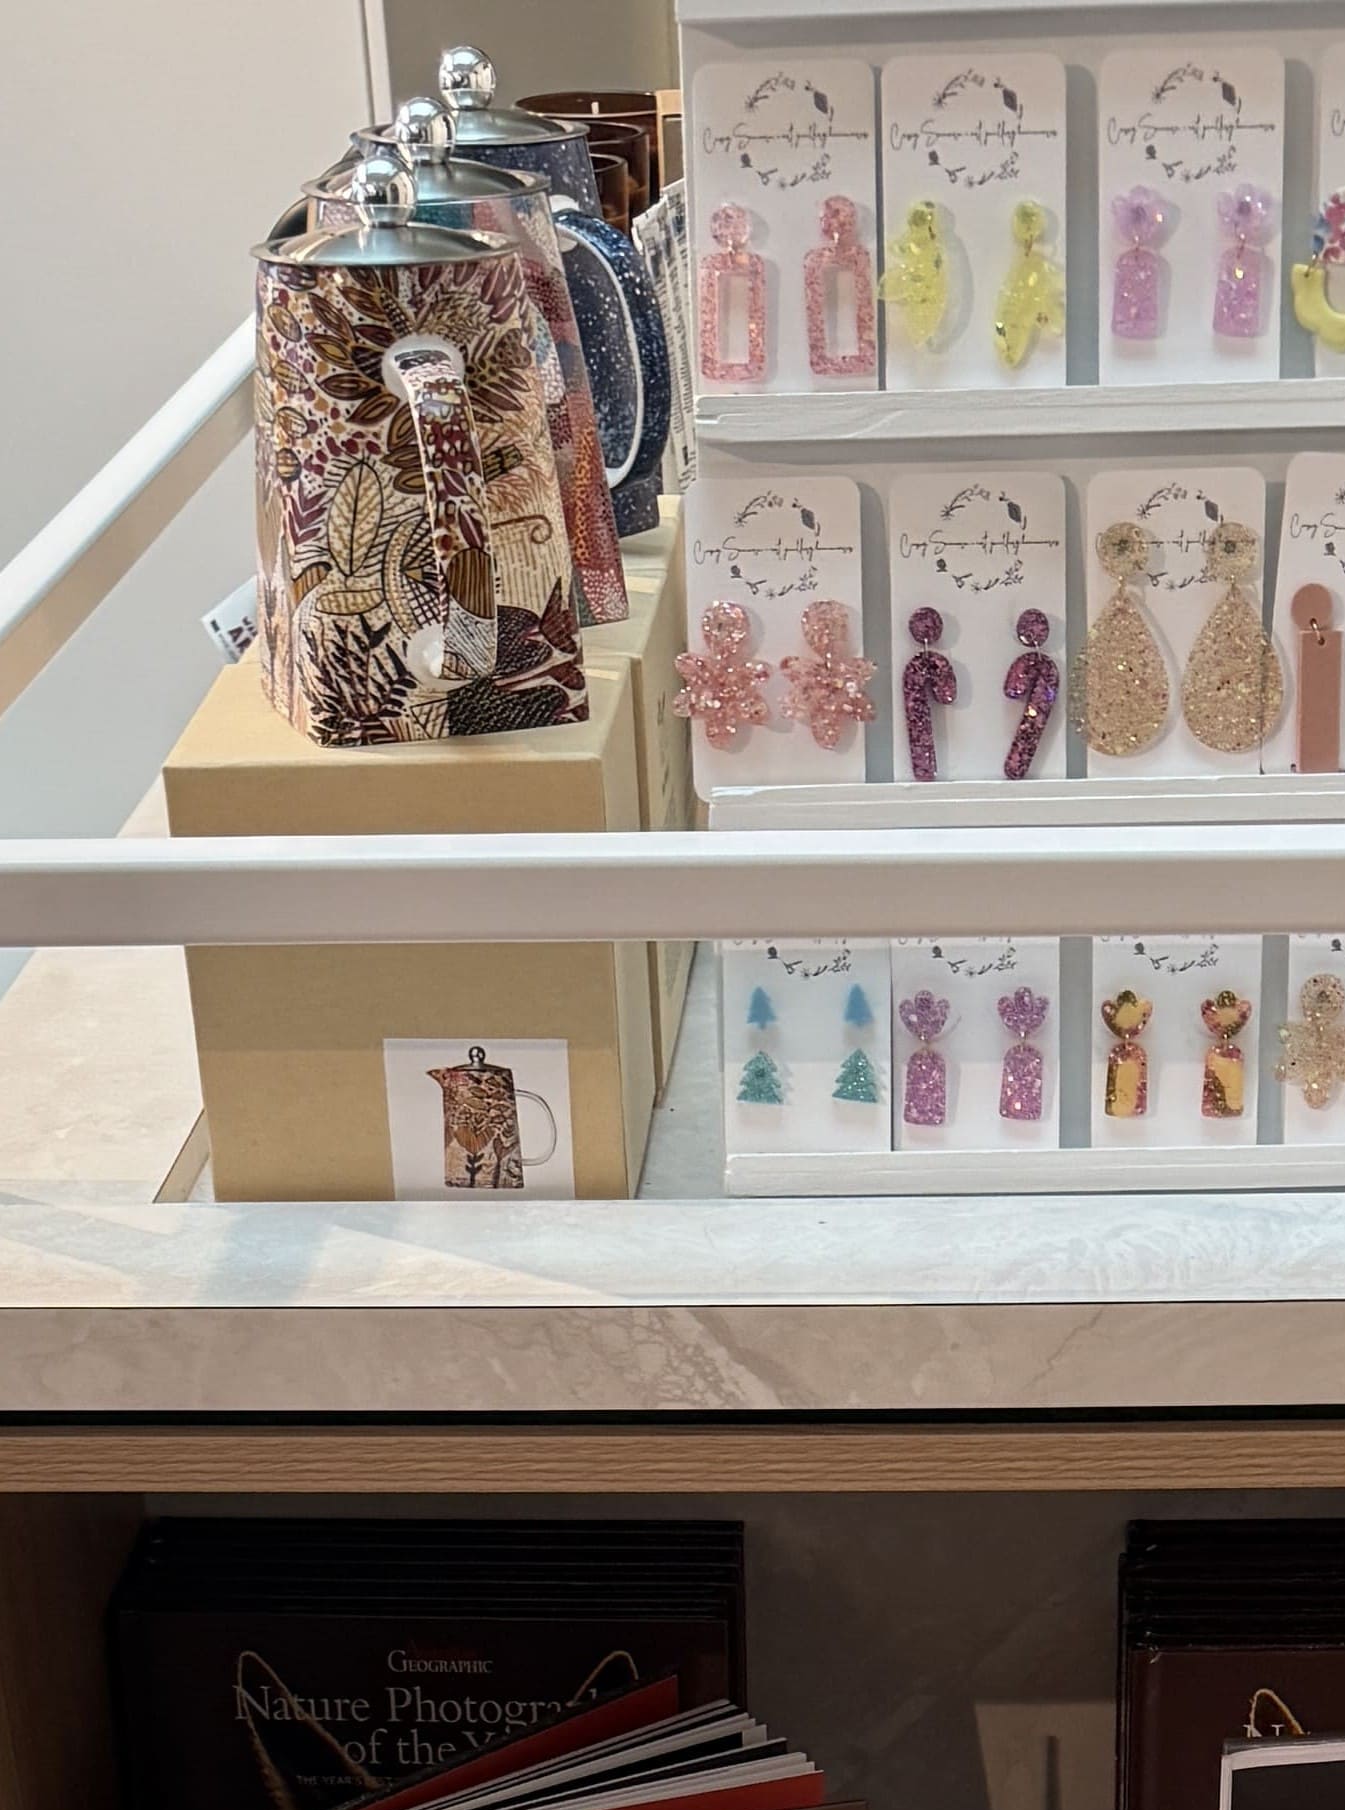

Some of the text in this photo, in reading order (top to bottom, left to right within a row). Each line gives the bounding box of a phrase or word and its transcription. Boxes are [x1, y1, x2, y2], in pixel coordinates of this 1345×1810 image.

[387, 1650, 494, 1674] GEOGRAPHIC
[232, 1685, 370, 1723] Nature
[345, 1728, 388, 1766] of
[397, 1729, 456, 1766] the
